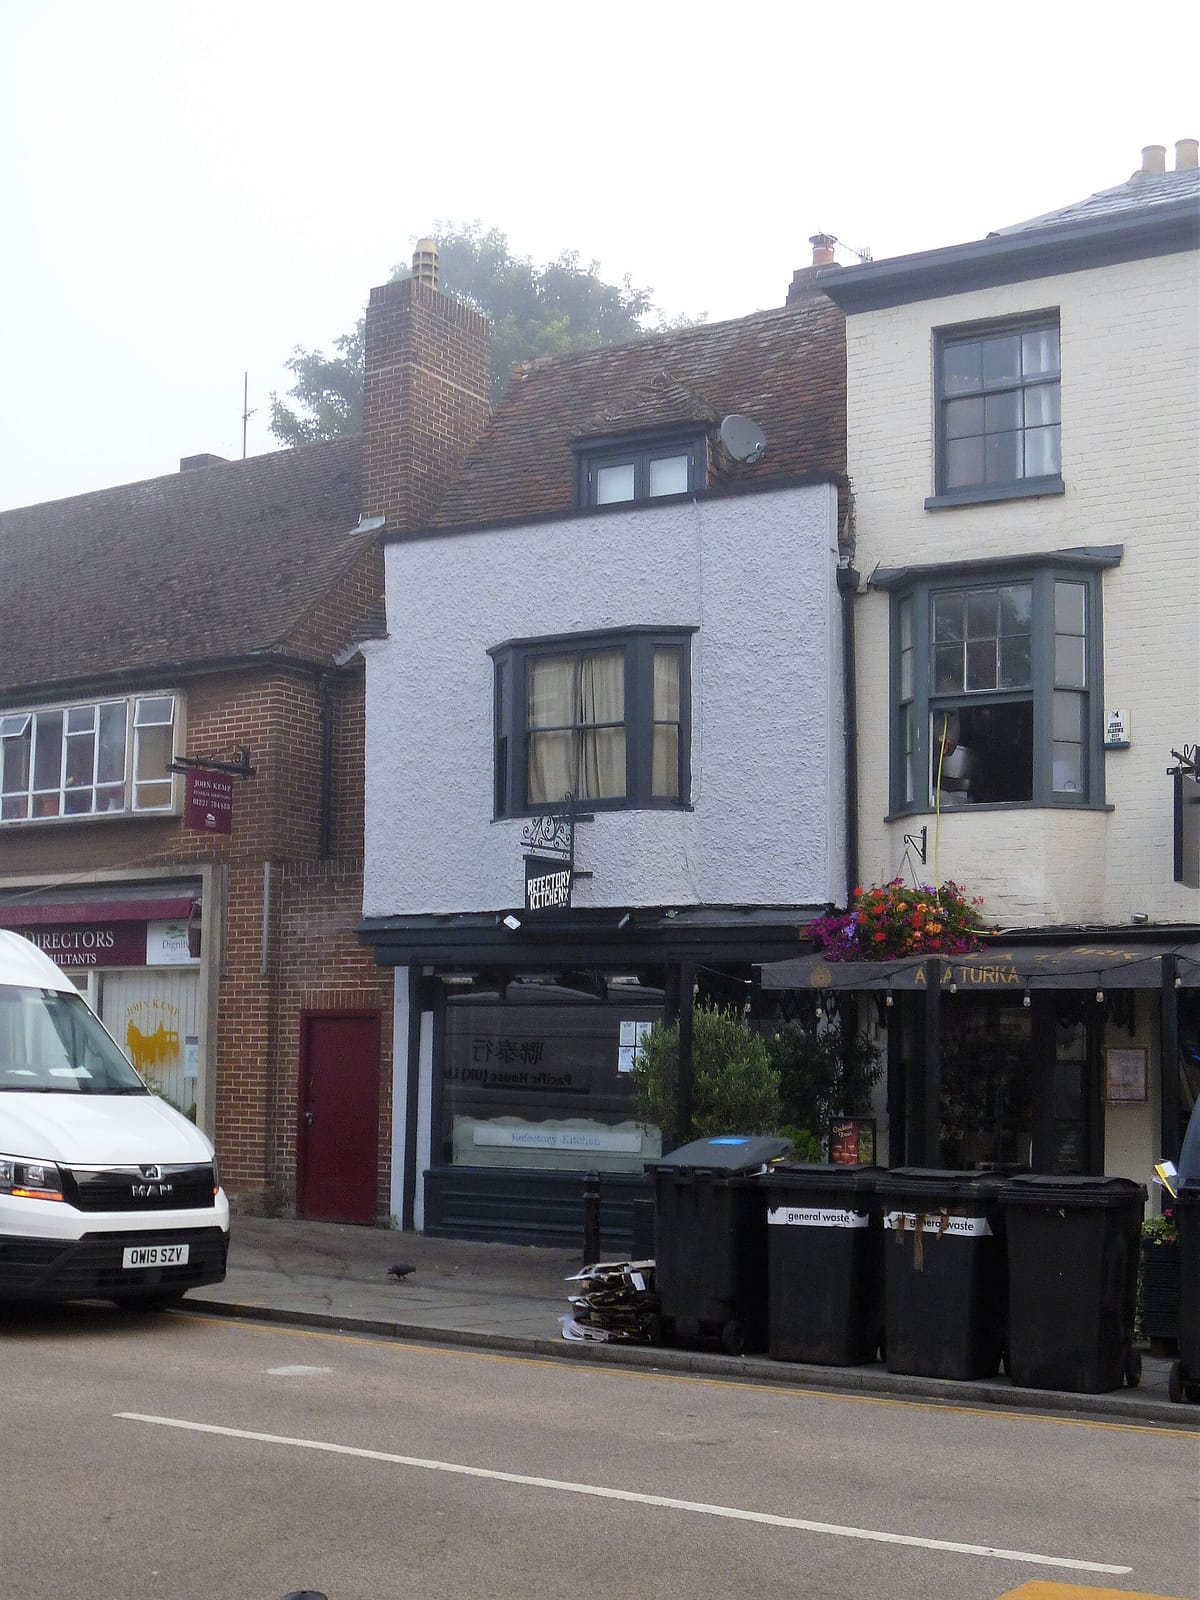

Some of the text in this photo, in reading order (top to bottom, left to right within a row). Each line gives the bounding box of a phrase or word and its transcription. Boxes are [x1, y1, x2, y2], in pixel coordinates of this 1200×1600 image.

[193, 779, 231, 792] JOHN KEMP
[527, 869, 570, 896] REFECTORY
[530, 887, 564, 911] KITCHEN
[24, 930, 114, 949] DIRECTORS
[914, 965, 1020, 984] A A TURKA
[126, 1001, 149, 1016] JOHN
[511, 1131, 600, 1146] Refectory Kitchen
[131, 1184, 173, 1197] MAN
[788, 1211, 821, 1222] general
[910, 1218, 943, 1228] gera
[131, 1247, 183, 1265] OW19 SZV
